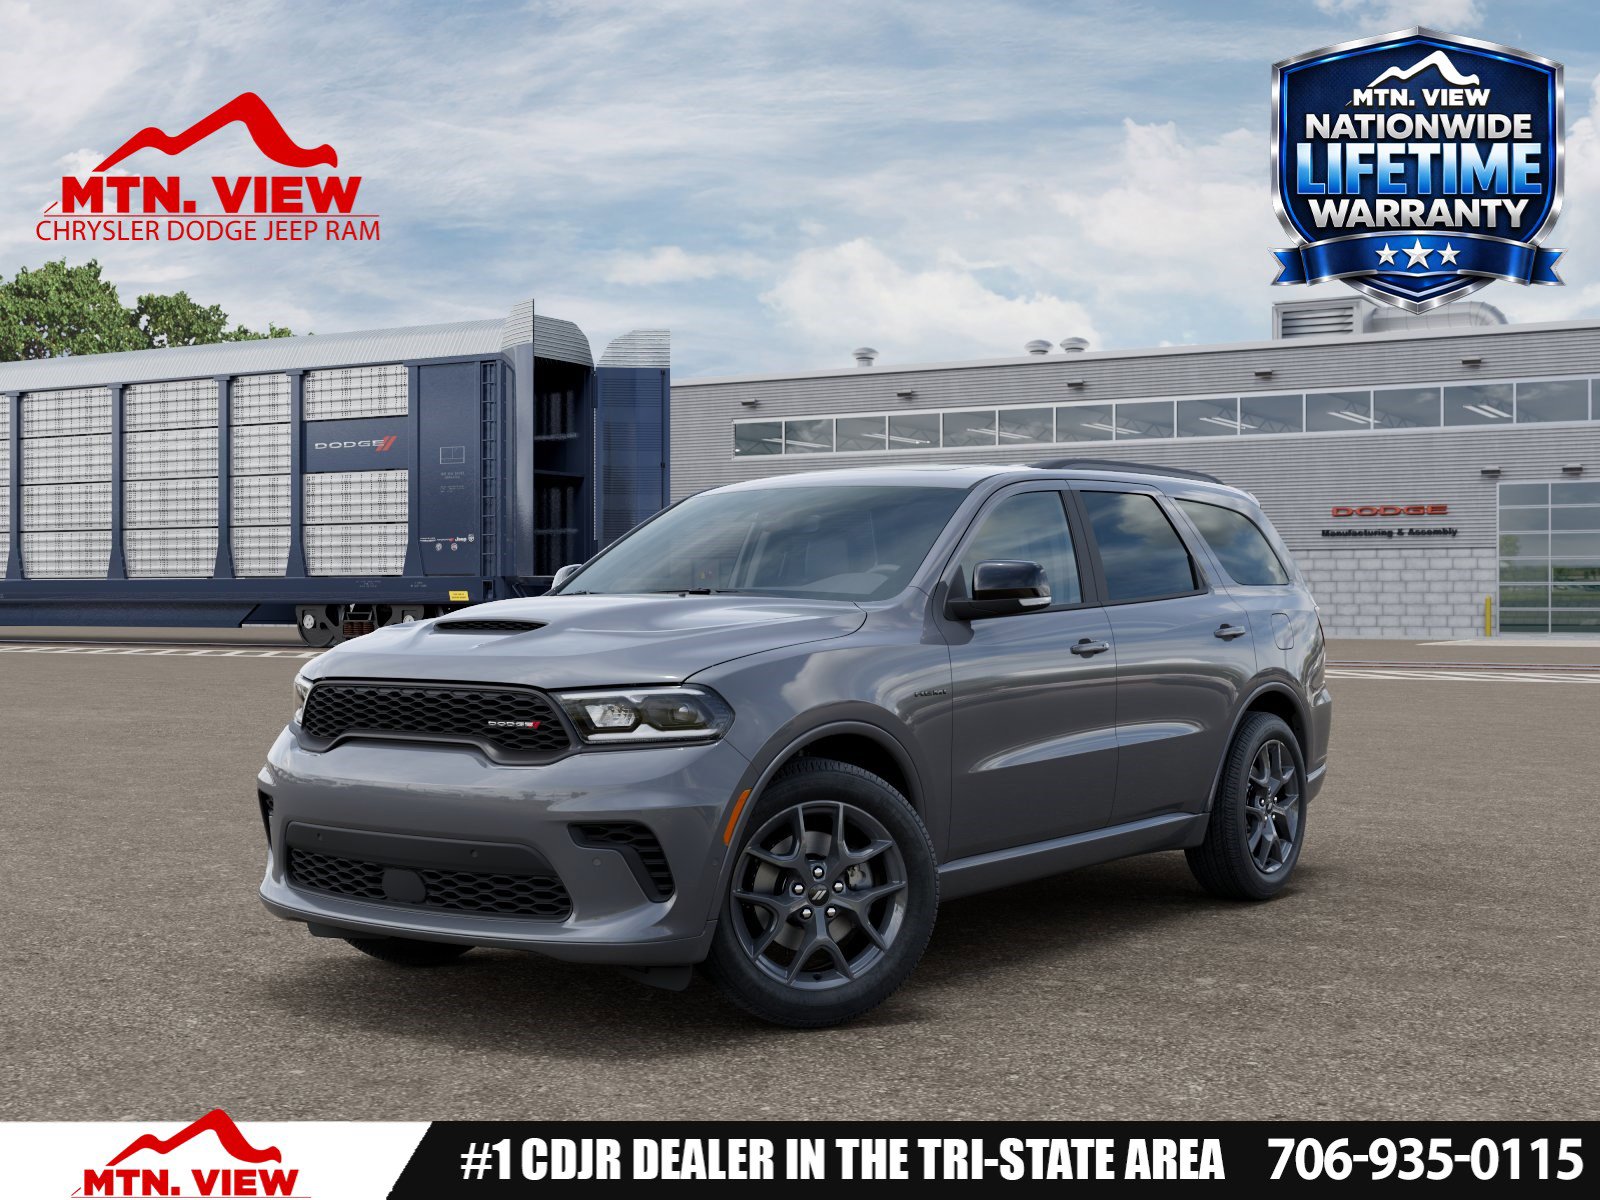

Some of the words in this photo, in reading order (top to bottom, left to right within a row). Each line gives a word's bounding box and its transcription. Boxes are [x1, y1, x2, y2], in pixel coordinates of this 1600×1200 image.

[314, 439, 386, 450] DODGE
[1331, 504, 1448, 517] DODGE
[1321, 529, 1393, 538] Manufacturing
[1397, 528, 1404, 536] &
[1407, 528, 1457, 537] Assembly
